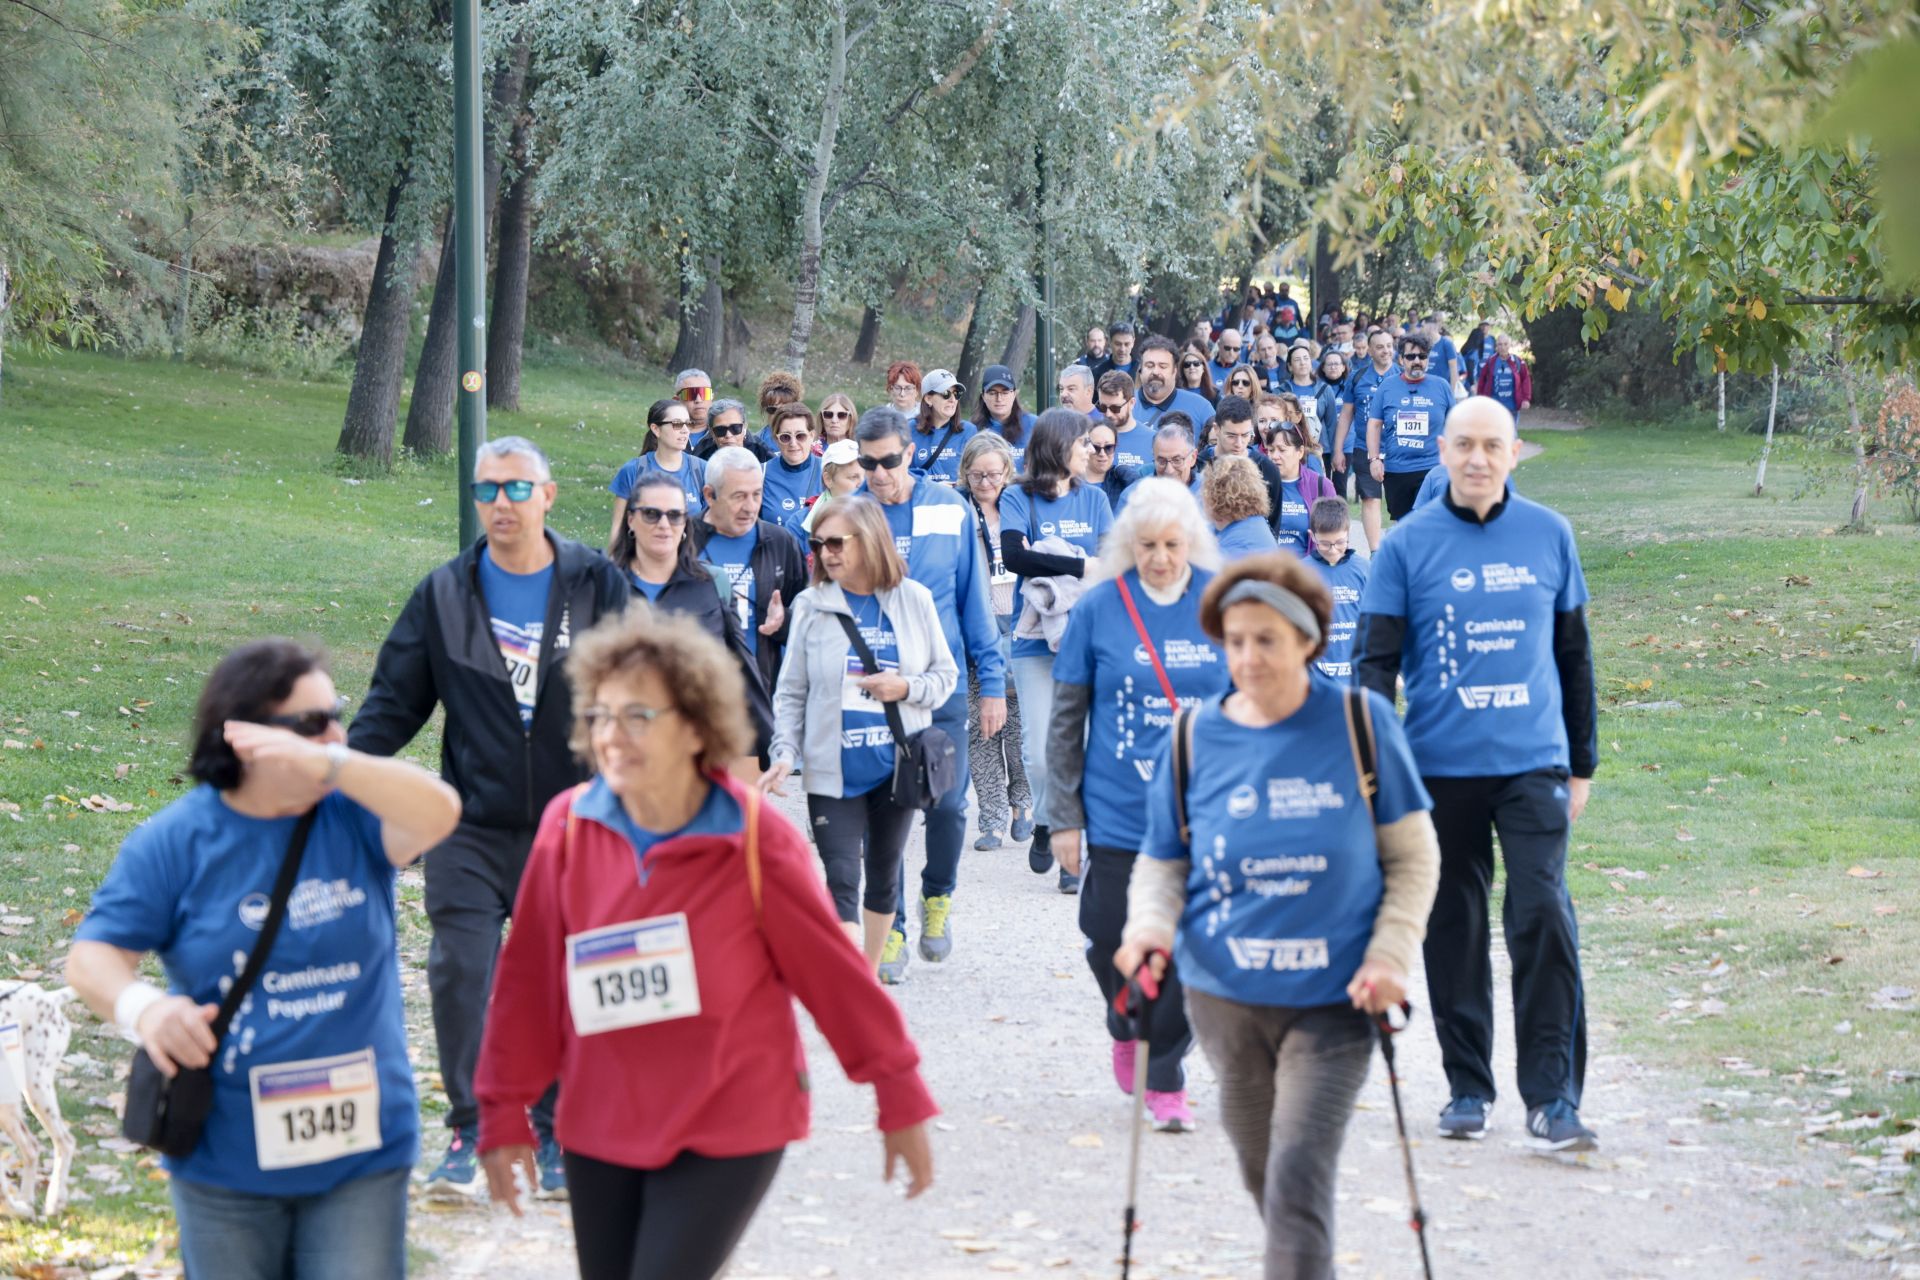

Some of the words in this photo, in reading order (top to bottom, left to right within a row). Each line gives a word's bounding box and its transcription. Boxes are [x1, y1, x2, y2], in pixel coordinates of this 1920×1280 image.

[1404, 421, 1421, 431] 1371
[1277, 537, 1296, 545] pular
[861, 630, 883, 638] ANCO
[1464, 618, 1526, 635] Caminata
[1328, 632, 1351, 643] opular
[1466, 637, 1516, 654] Popular
[508, 658, 531, 687] 70
[1143, 713, 1175, 729] Popu
[1240, 854, 1328, 876] Caminata
[1245, 877, 1311, 899] Popular
[262, 961, 361, 993] Caminata
[591, 963, 670, 1008] 1399
[267, 990, 347, 1021] Popular
[281, 1098, 356, 1144] 1349
